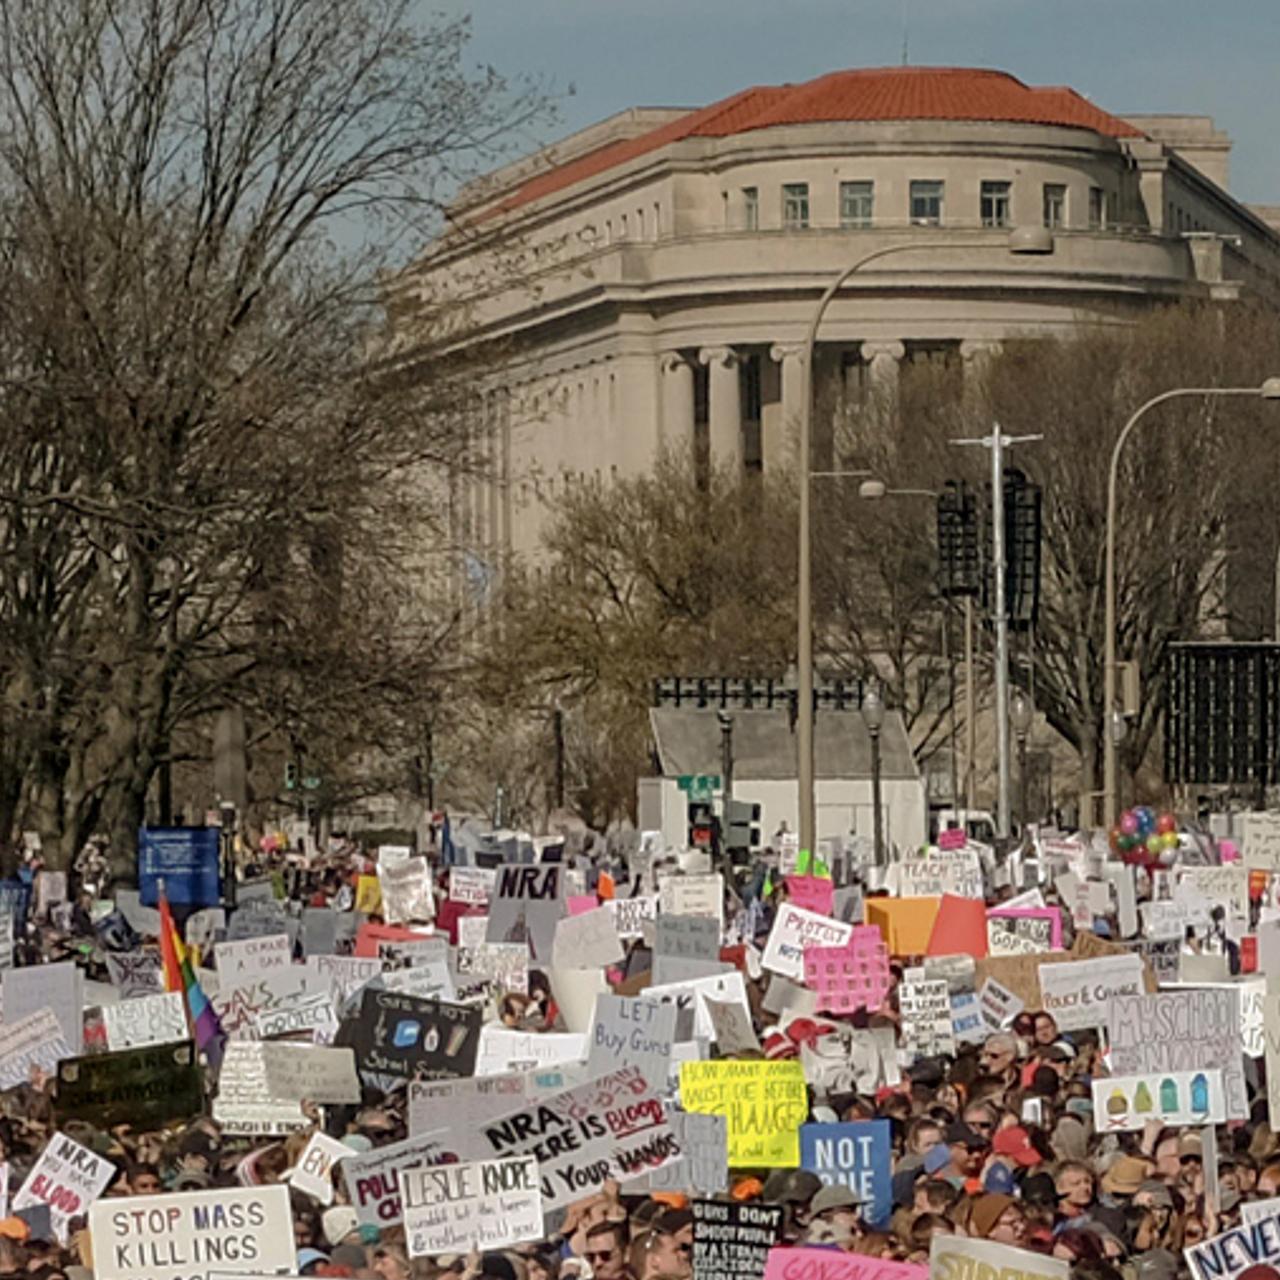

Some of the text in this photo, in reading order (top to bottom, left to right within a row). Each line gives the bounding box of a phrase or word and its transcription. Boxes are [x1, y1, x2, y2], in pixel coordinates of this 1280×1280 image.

[57, 1139, 98, 1176] NRA
[558, 1133, 681, 1192] YOUR HANDS
[815, 1137, 873, 1169] NOT
[113, 1202, 264, 1236] STOP MASS
[117, 1236, 257, 1268] KILLINGS
